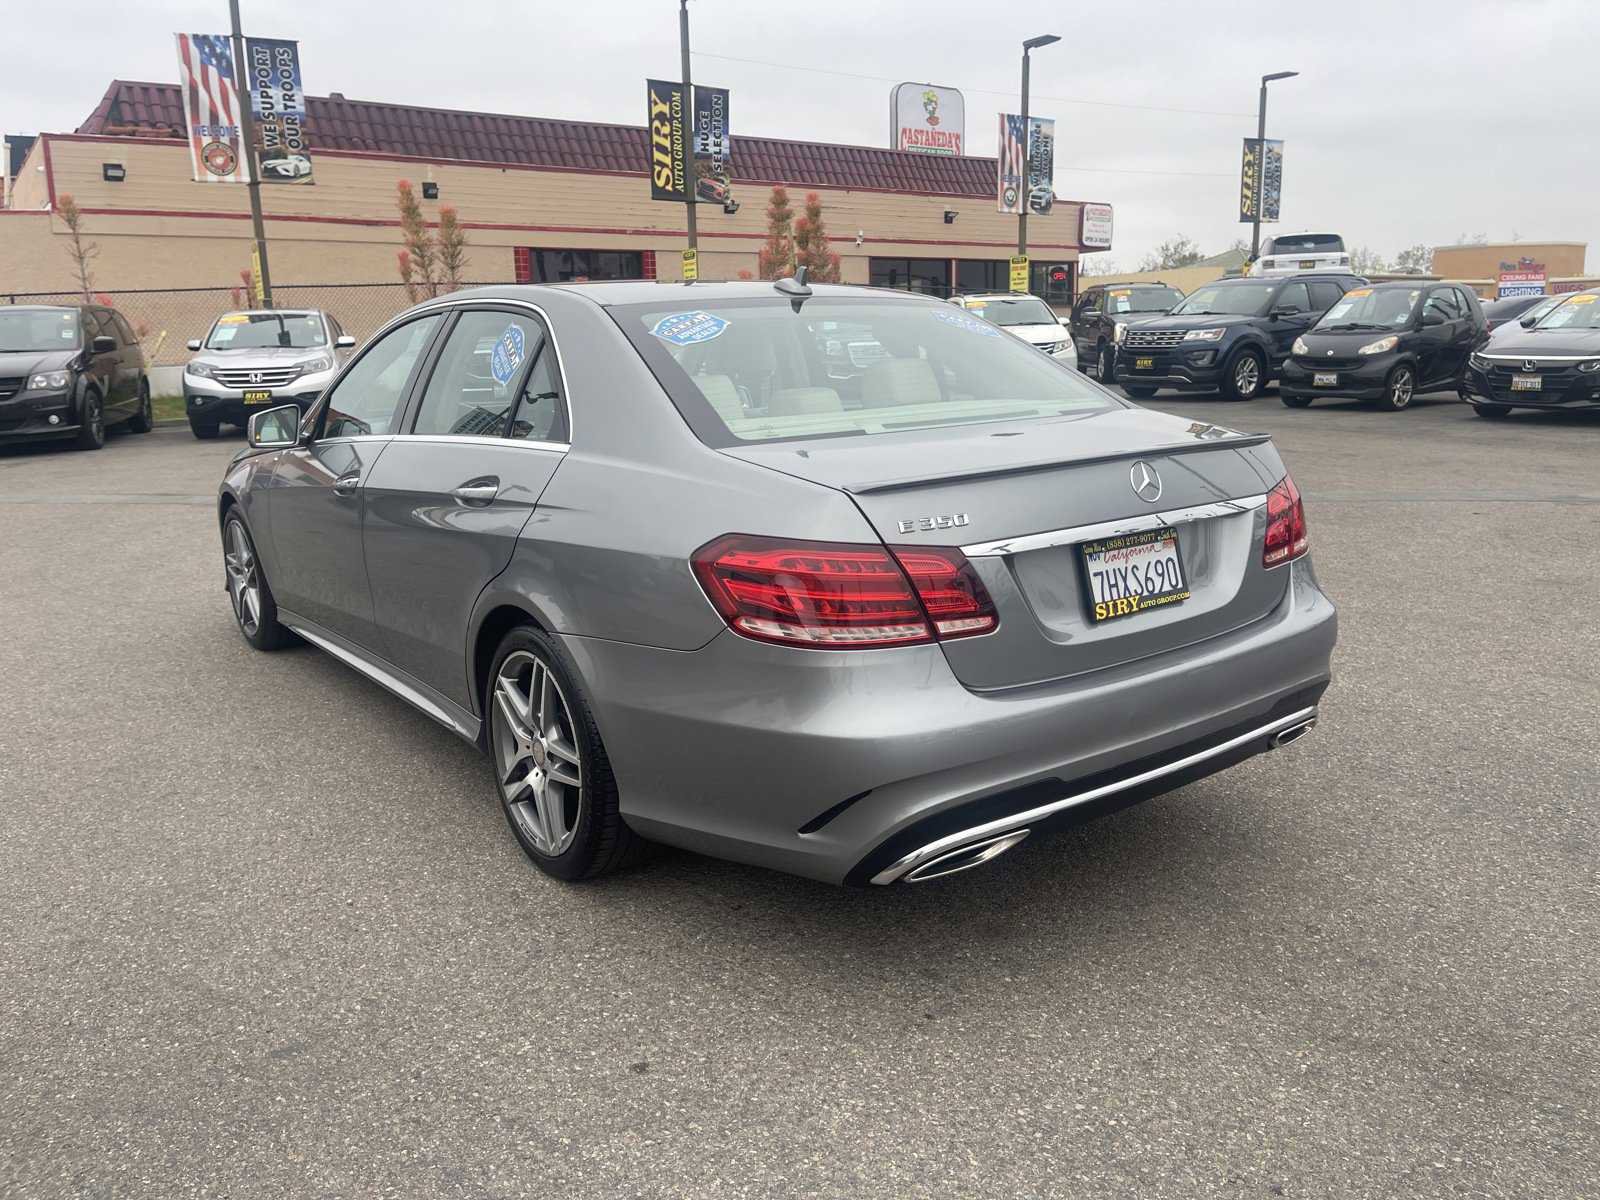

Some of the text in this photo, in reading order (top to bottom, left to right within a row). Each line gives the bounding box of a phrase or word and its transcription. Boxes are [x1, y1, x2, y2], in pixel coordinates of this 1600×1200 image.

[254, 47, 280, 149] WE SUPPORT
[275, 48, 302, 150] OUR TROOPS
[193, 124, 240, 138] WELCOME
[651, 89, 673, 192] SIRY
[671, 91, 684, 192] AUTO GROUP.COM
[700, 111, 710, 153] HUGE
[712, 94, 723, 173] SELECTION
[1242, 144, 1255, 216] SIRY
[1053, 272, 1067, 280] OPEN
[1501, 287, 1542, 297] LIGHTING
[245, 392, 270, 400] SIRY
[898, 513, 969, 534] E 350
[1103, 543, 1161, 565] California
[1093, 557, 1184, 603] 7HXS690
[1095, 591, 1191, 620] SIRY AUTO GROUP.COM
